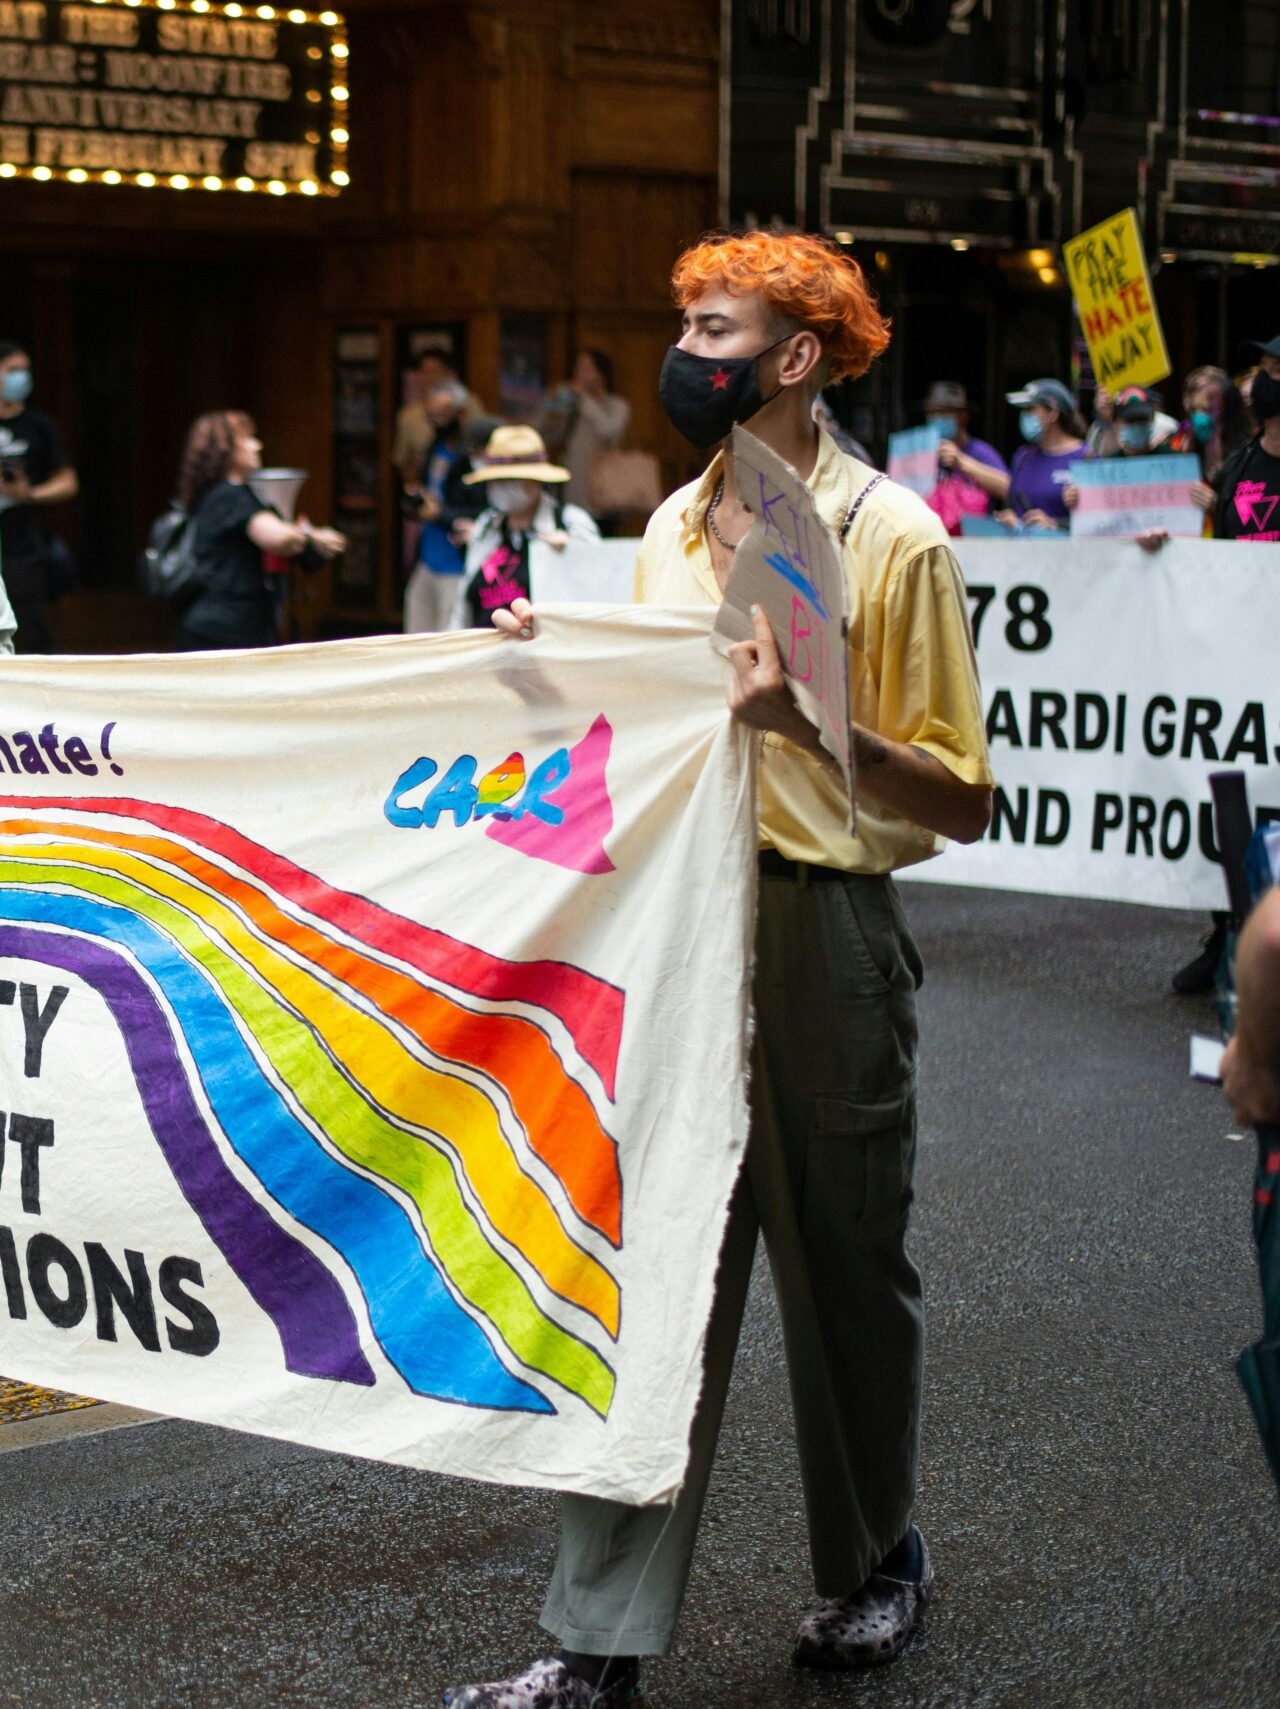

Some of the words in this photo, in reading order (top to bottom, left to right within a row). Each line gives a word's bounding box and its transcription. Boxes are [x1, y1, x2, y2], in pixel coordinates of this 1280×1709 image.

[61, 6, 139, 47] THE
[157, 14, 277, 58] STATE
[0, 86, 262, 138] ANNIVERSARY
[35, 127, 227, 175] FEBRUARY
[1073, 223, 1125, 284] PRAY
[1085, 277, 1151, 344] HATE
[1100, 322, 1152, 384] AWAY
[986, 688, 1126, 754] ARDI
[983, 784, 1071, 848] ND
[1091, 793, 1280, 865] PROU
